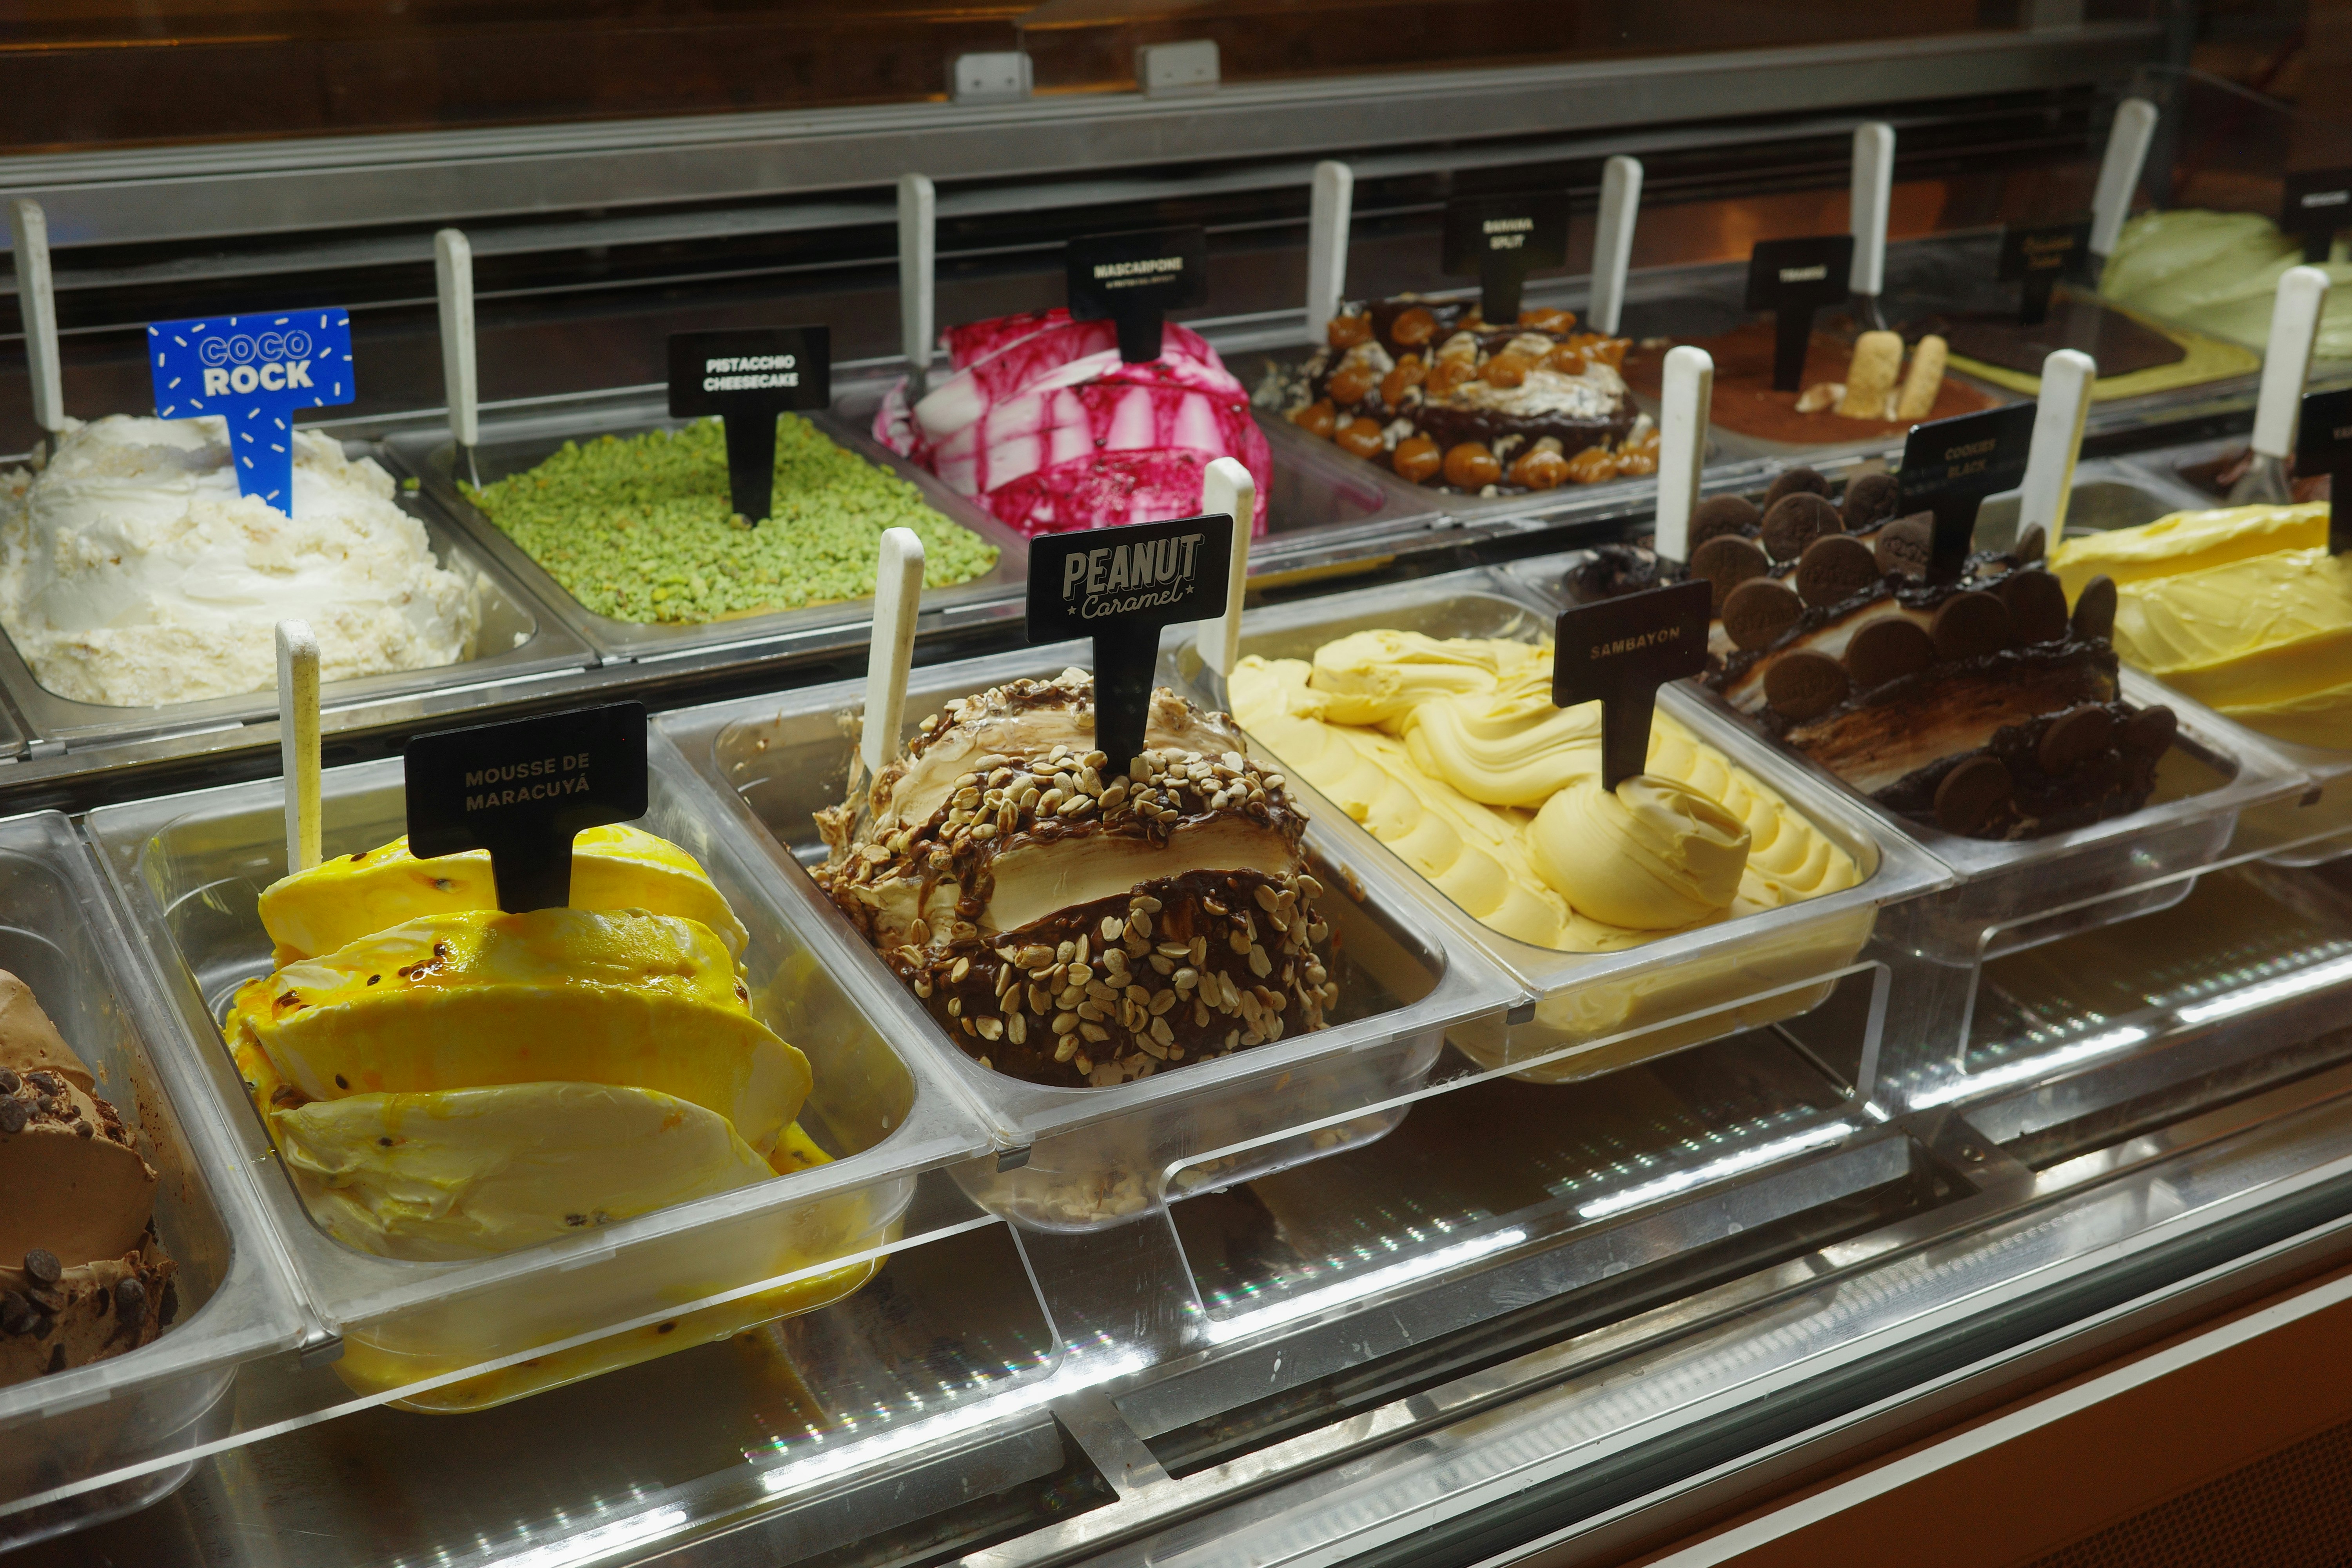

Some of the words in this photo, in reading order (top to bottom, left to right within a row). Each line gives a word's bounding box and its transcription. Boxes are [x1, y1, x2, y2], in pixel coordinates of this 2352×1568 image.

[1094, 257, 1183, 279] MASCARPONE
[199, 330, 313, 367] COCO
[706, 354, 796, 374] PISTACCHIO
[203, 359, 314, 397] ROCK
[702, 372, 799, 392] CHEESECAKE
[1062, 533, 1205, 601] PEANUT
[1081, 575, 1183, 619] Caramel
[1590, 627, 1680, 660] SAMBAYON
[466, 757, 556, 787] MOUSSE
[563, 753, 589, 771] DE
[466, 773, 590, 811] MARACUYÁ
